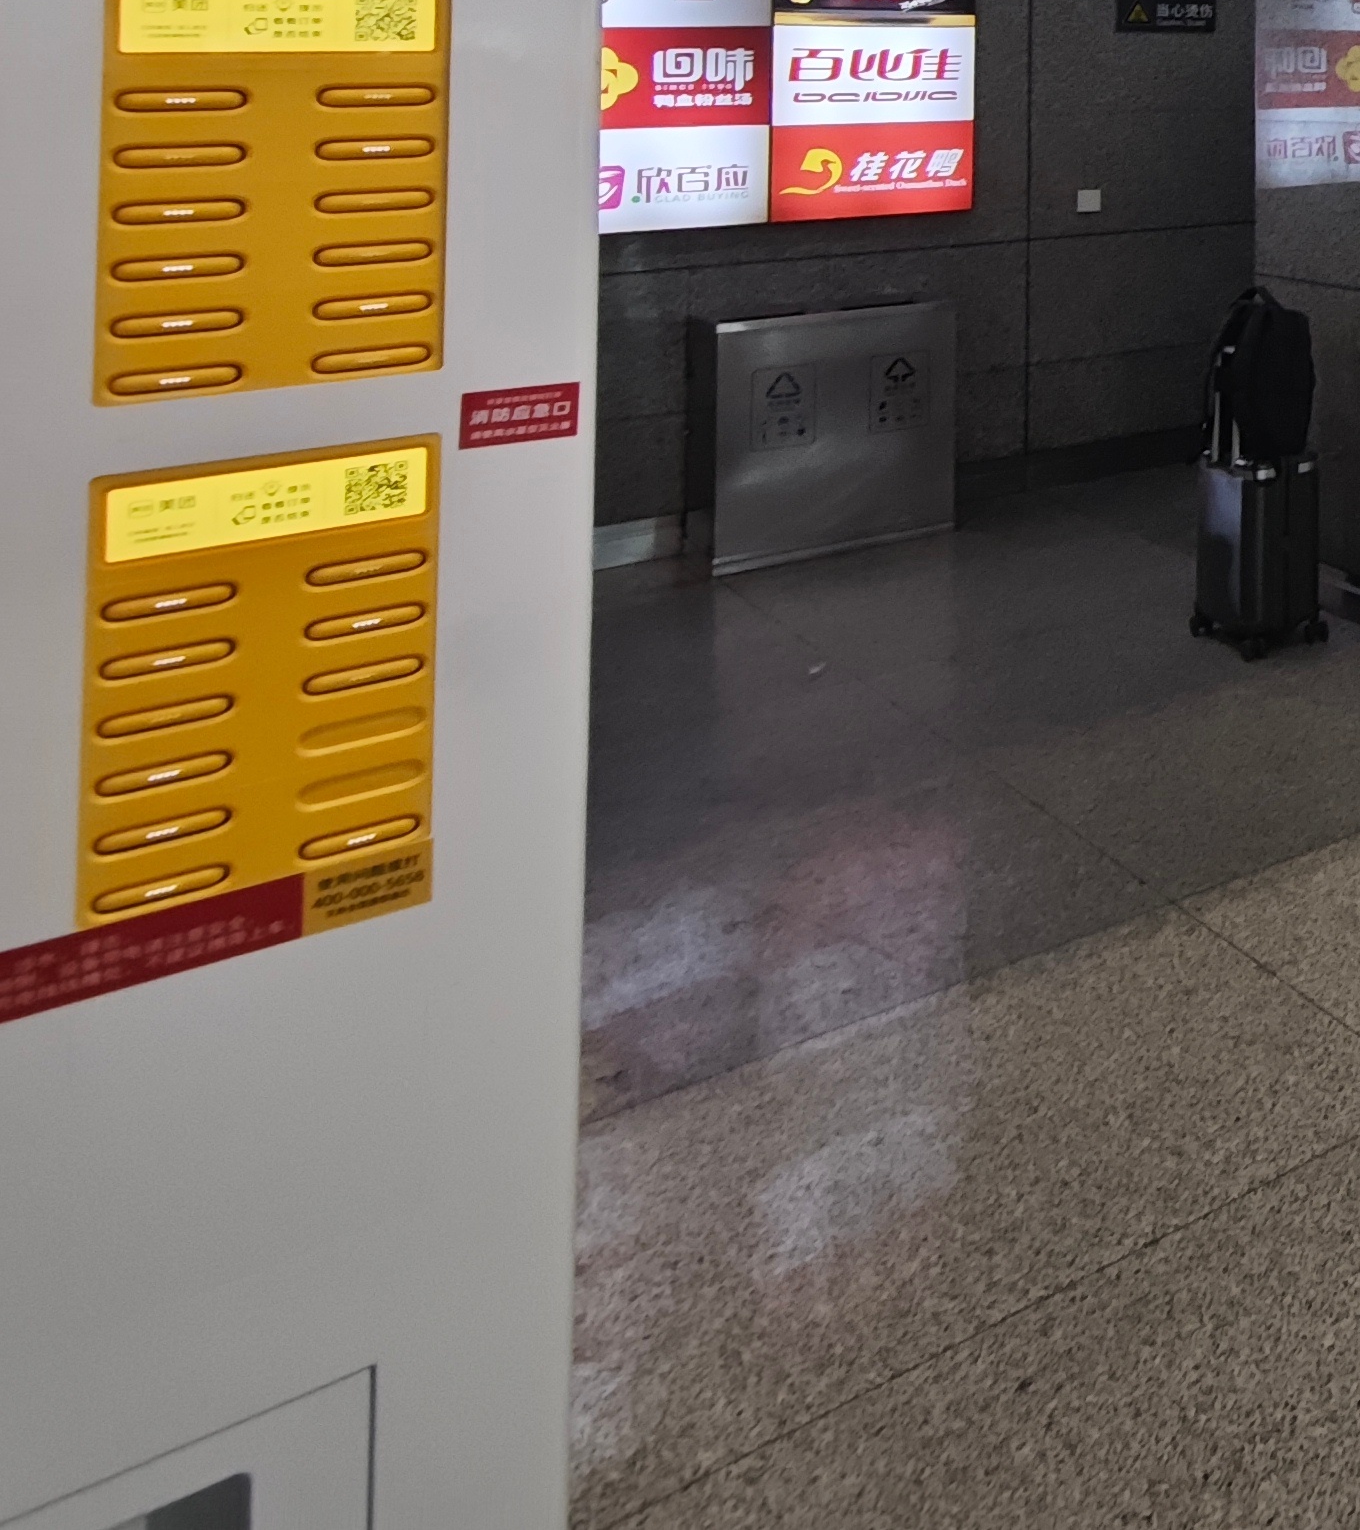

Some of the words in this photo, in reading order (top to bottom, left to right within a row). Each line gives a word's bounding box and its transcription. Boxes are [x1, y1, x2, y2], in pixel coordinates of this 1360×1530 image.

[652, 47, 755, 91] 回味
[850, 148, 965, 182] 桂花鸭
[637, 164, 750, 203] 欣百应
[696, 190, 750, 202] BUYING
